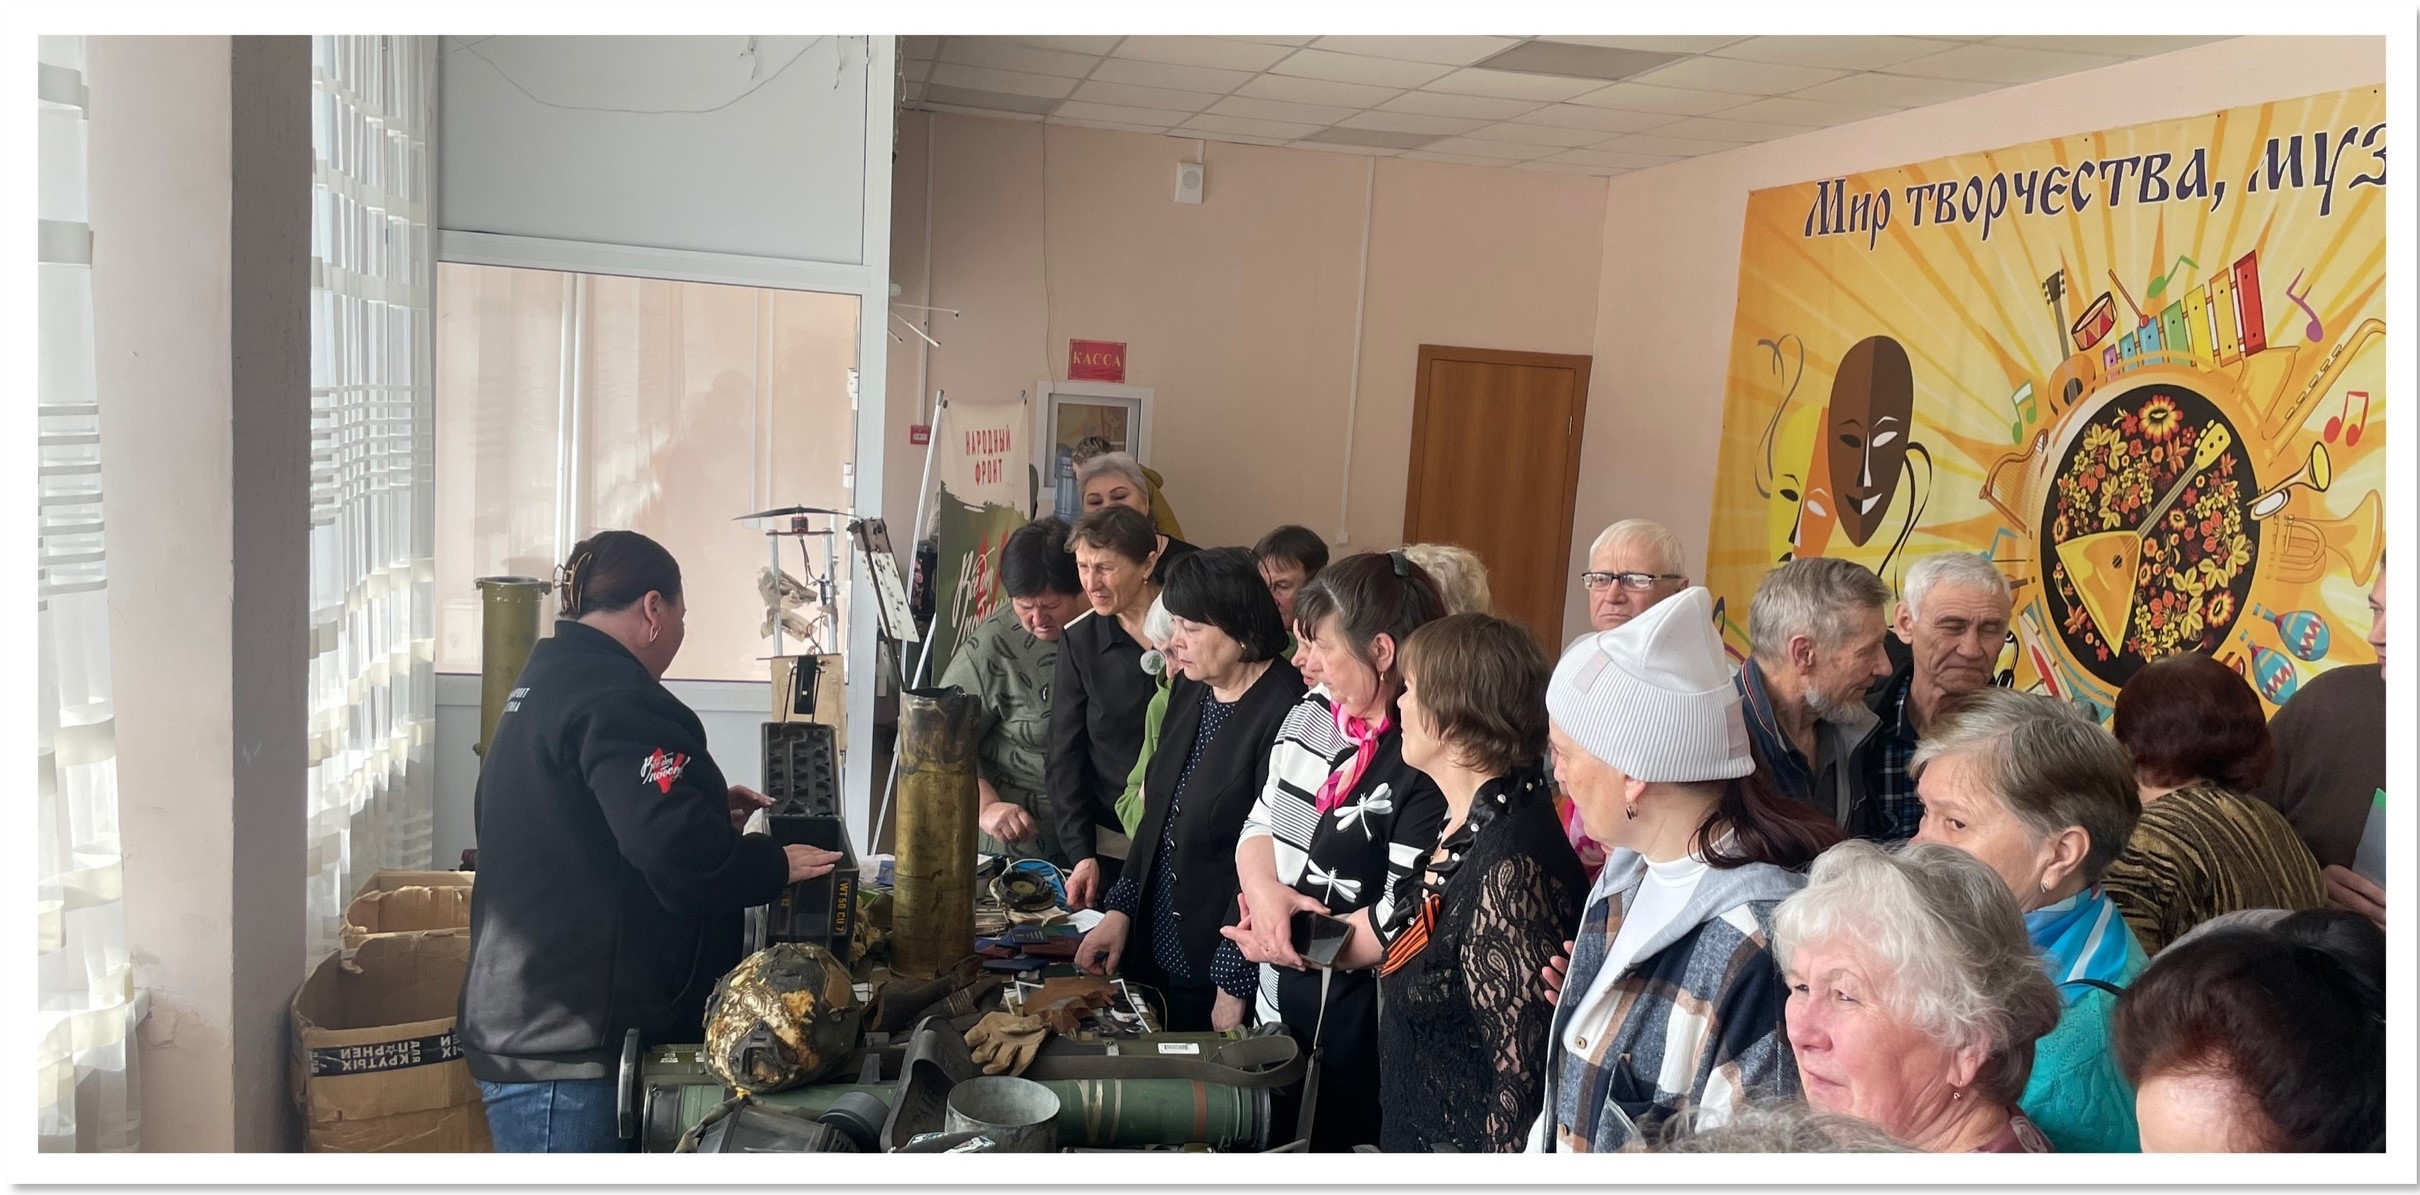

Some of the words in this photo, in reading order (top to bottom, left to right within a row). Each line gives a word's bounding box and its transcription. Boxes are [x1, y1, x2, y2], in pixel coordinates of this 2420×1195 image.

[1804, 179, 1892, 251] Мир
[1906, 147, 2227, 243] творчества,
[1073, 351, 1121, 367] КАССА
[965, 424, 1011, 456] НАРОДНЫЙ
[975, 459, 1003, 486] ФРОНТ
[342, 1053, 409, 1071] КРУТЫХ
